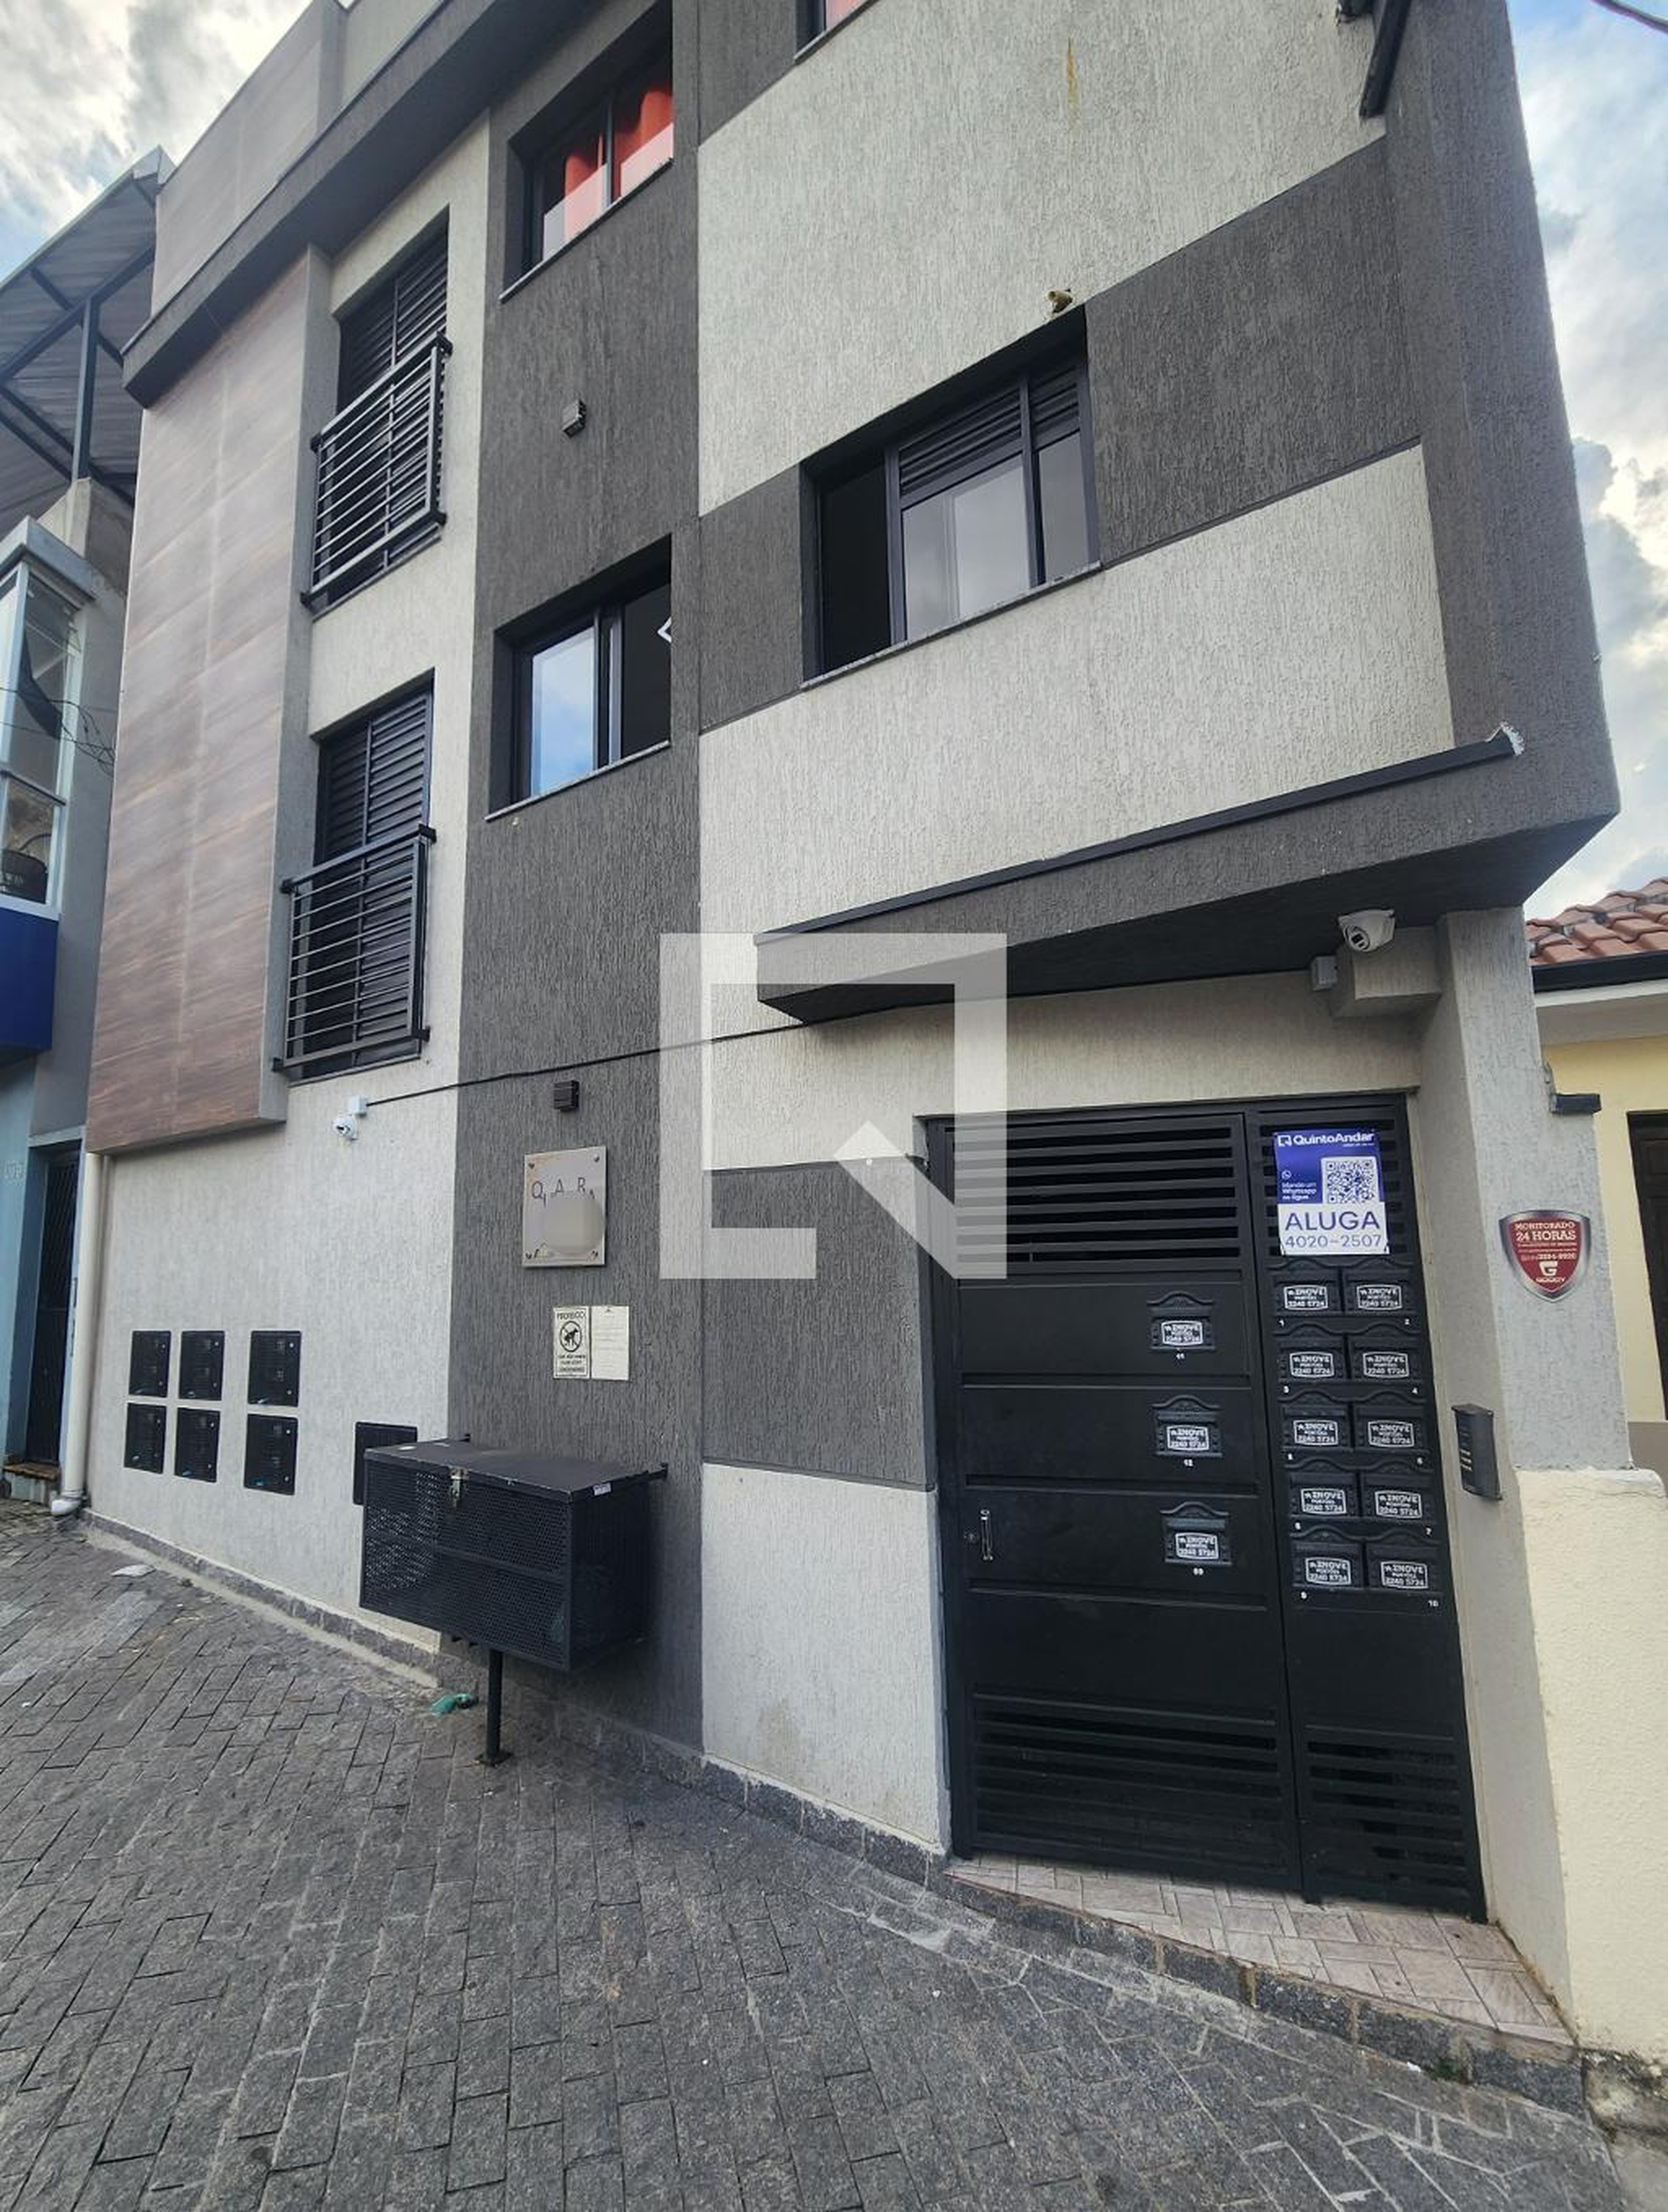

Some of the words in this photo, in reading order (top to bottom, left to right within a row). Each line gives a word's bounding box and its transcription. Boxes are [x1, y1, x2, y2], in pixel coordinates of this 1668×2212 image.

[1293, 1132, 1374, 1145] QuintoAndar
[1285, 1211, 1380, 1231] ALUGA
[1514, 1221, 1575, 1230] MONITORADO
[1516, 1231, 1530, 1241] 24
[1532, 1230, 1576, 1241] HORAS
